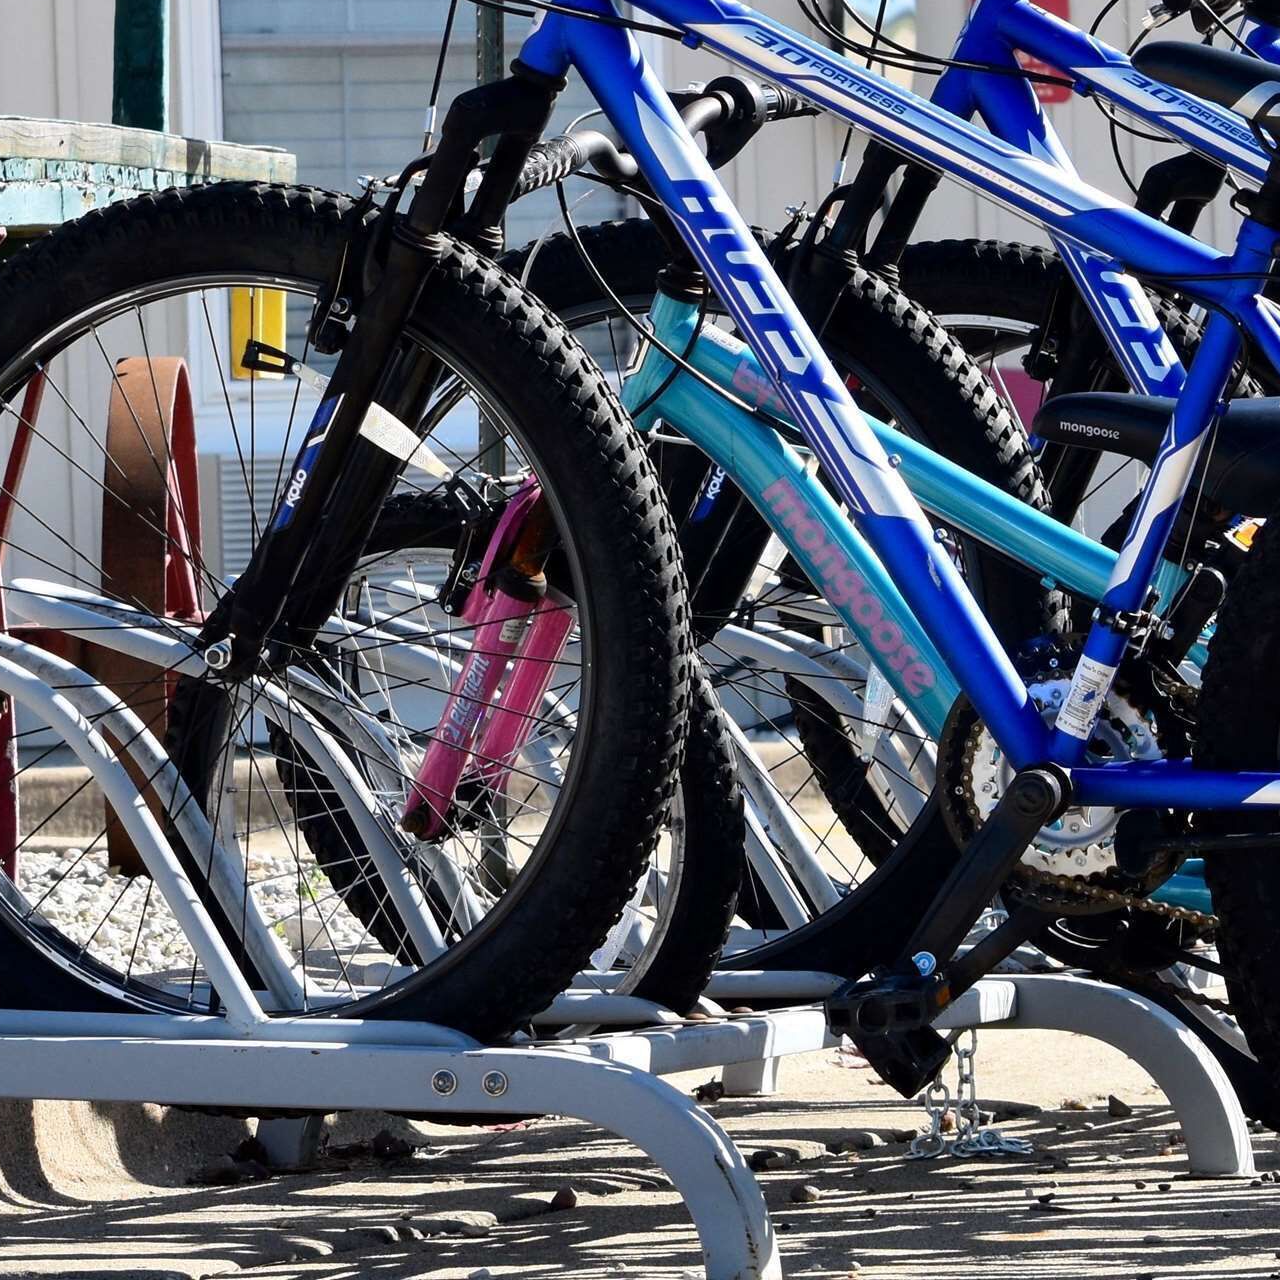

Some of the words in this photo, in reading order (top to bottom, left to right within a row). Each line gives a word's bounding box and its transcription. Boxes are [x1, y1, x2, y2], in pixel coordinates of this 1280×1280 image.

[744, 29, 811, 66] 3.0
[809, 61, 908, 116] FORTRESS
[1122, 73, 1181, 105] 3.0
[669, 174, 850, 407] HUFFY
[1059, 420, 1120, 440] mongoose
[285, 468, 307, 508] KOLO
[761, 475, 935, 698] mongoose
